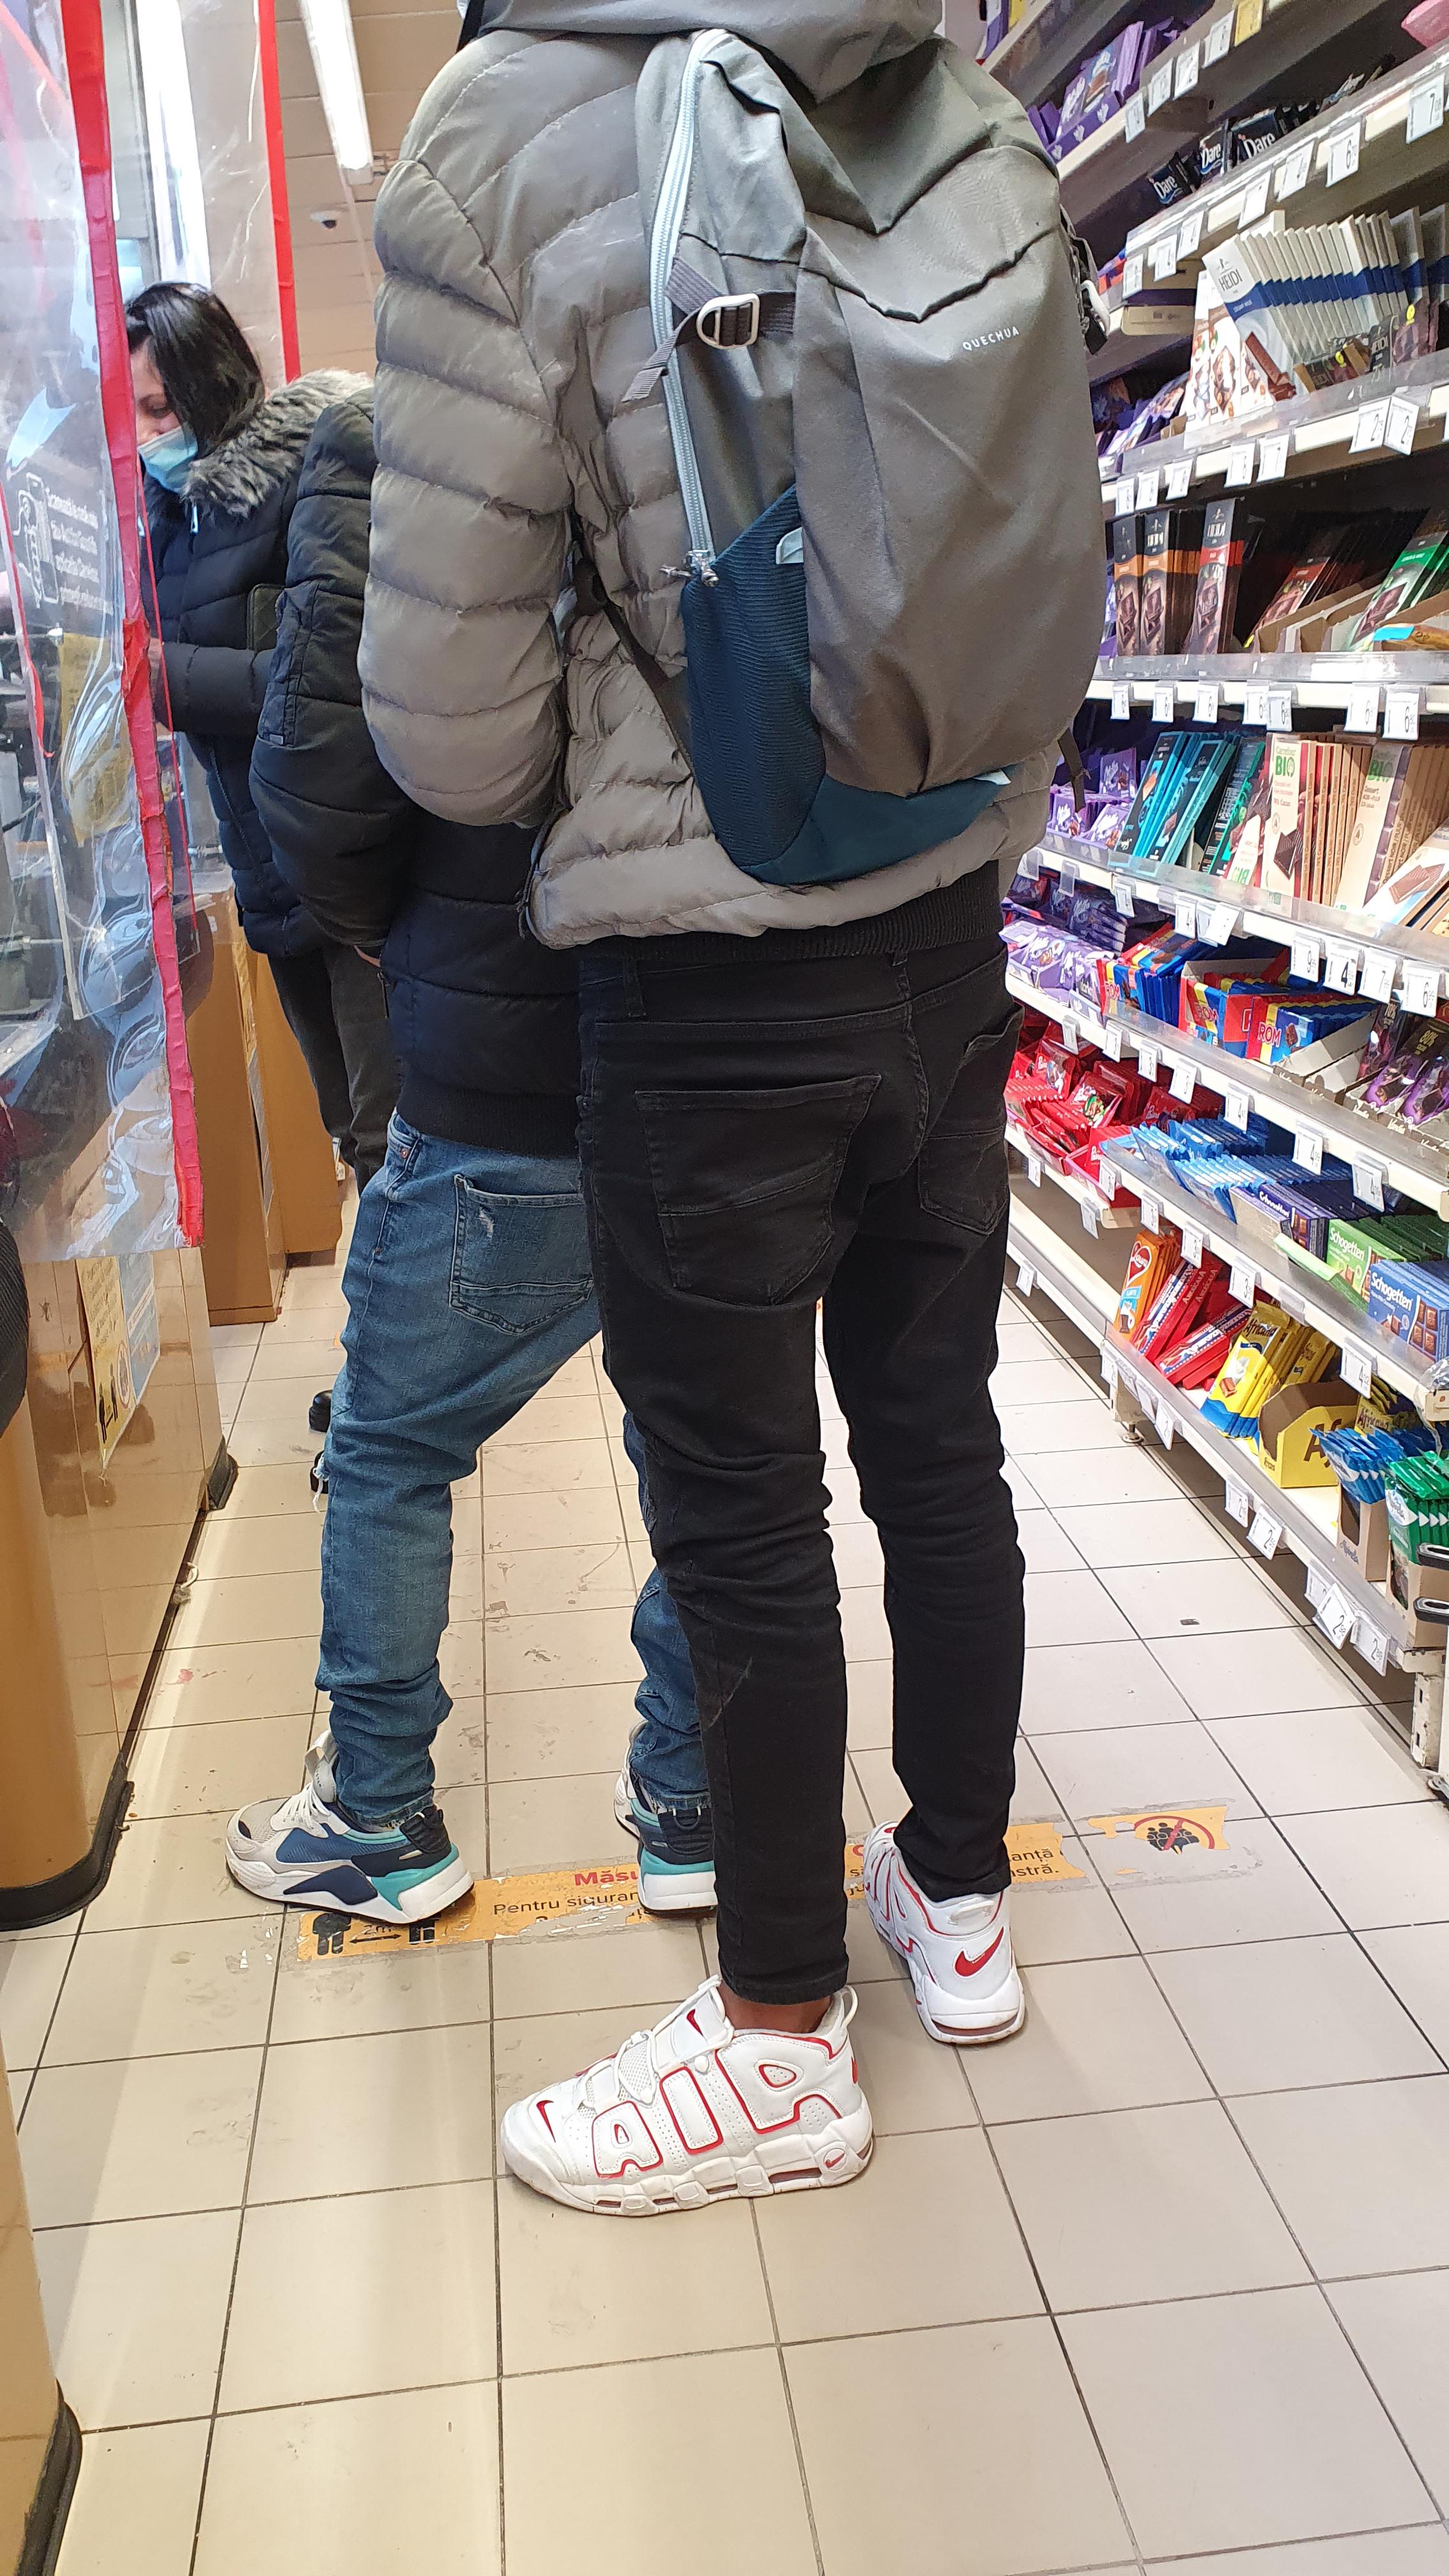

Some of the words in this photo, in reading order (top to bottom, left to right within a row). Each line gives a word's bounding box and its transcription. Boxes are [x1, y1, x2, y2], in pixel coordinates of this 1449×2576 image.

[1201, 142, 1221, 169] Dare
[1243, 132, 1275, 159] Dare
[1153, 175, 1177, 199] Dare
[1218, 268, 1243, 291] HEIDI
[962, 326, 1020, 351] QUECHUA
[1275, 755, 1296, 778] BIO
[1340, 961, 1349, 988] 4
[1378, 969, 1386, 993] 7
[1423, 981, 1429, 1008] 6
[1193, 1002, 1217, 1022] ROM
[1257, 1022, 1282, 1047] ROM
[1419, 1030, 1439, 1047] 80%
[1330, 1227, 1365, 1261] Schogetten
[1371, 1272, 1413, 1312] Schogetten
[1263, 1529, 1273, 1550] 2
[1333, 1614, 1345, 1636] 2
[1370, 1638, 1378, 1661] 2
[494, 1899, 560, 1915] Pentru
[592, 2038, 842, 2179] AIR
